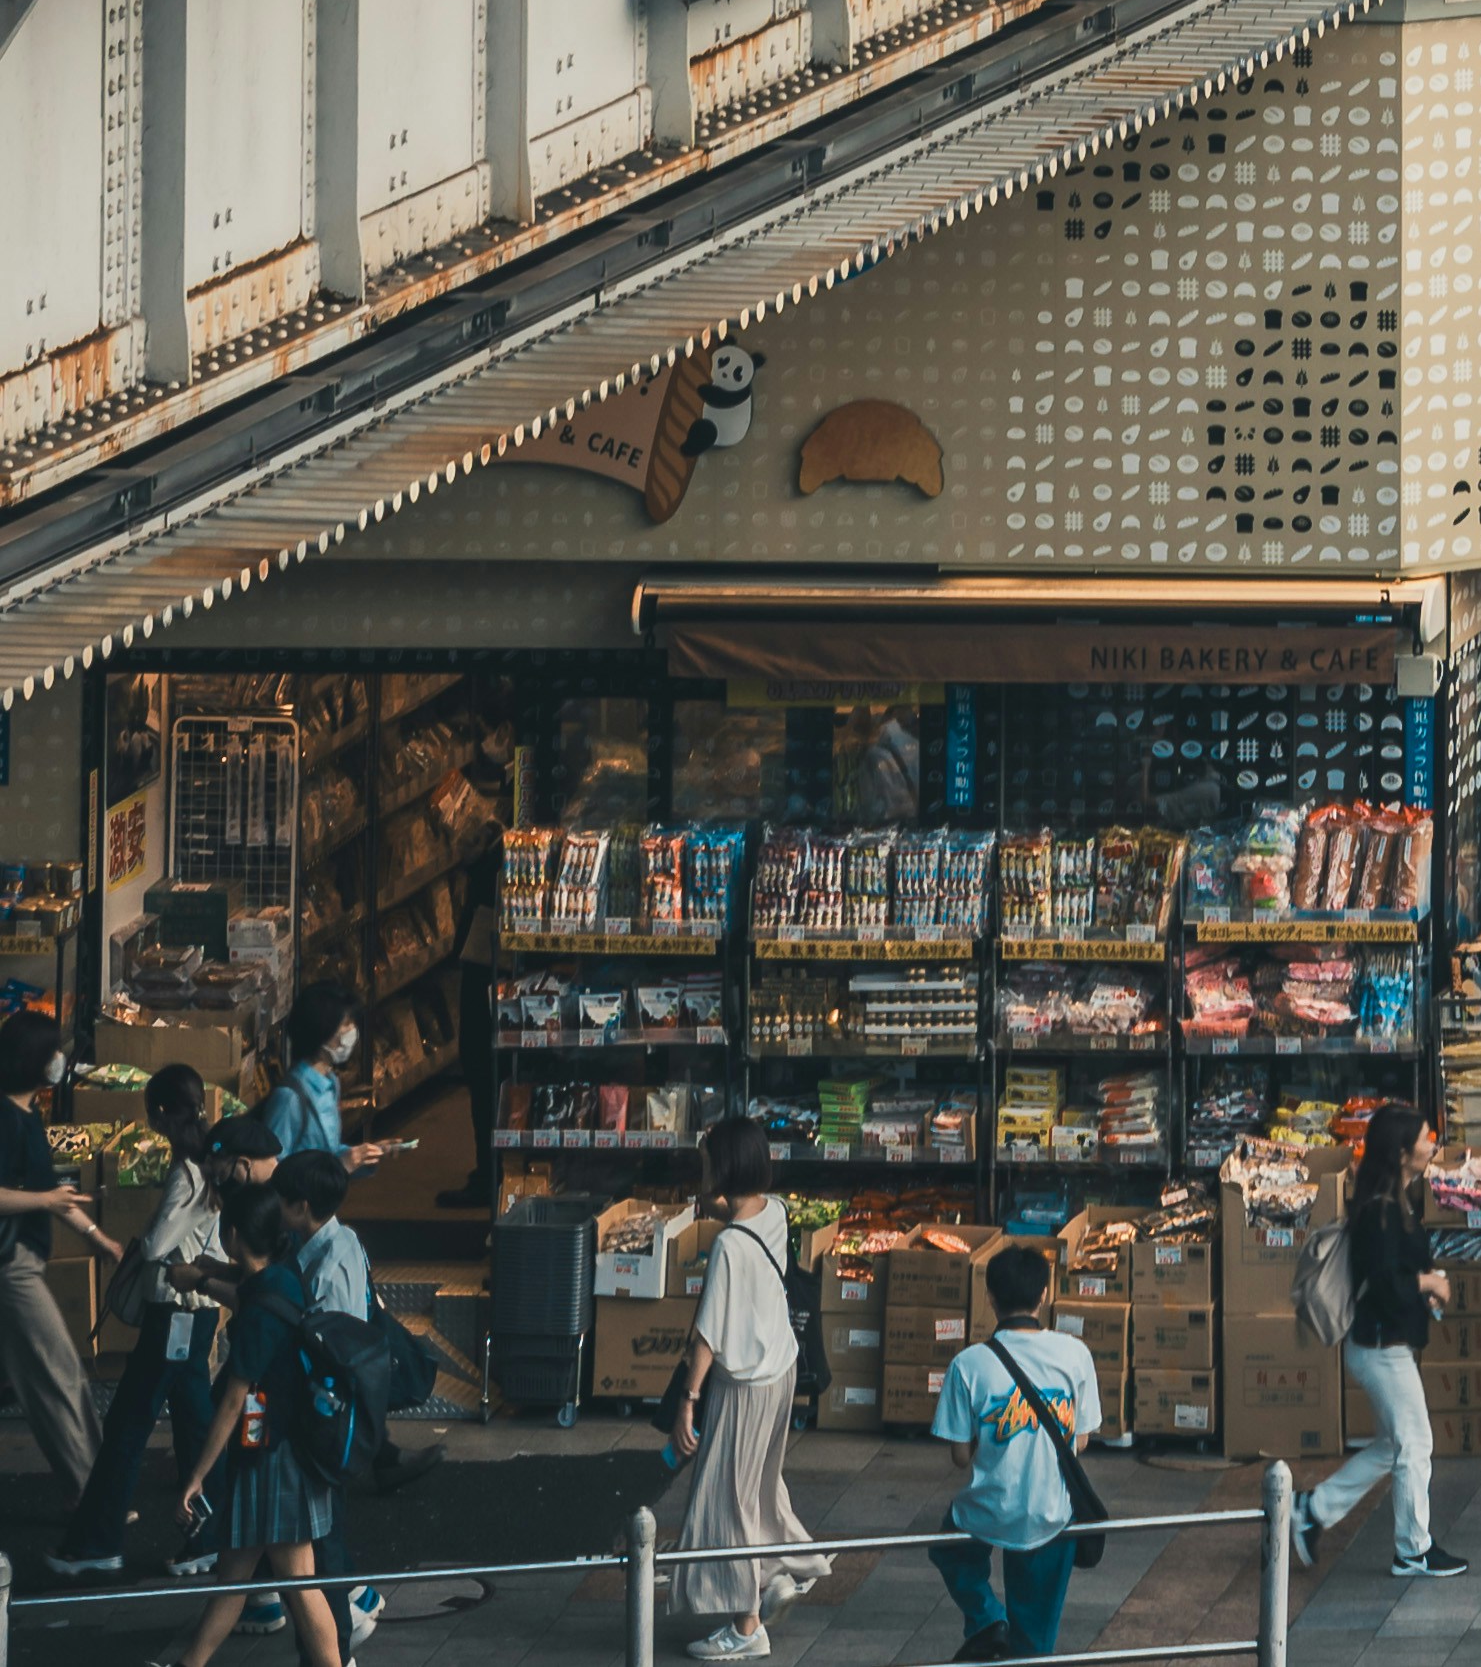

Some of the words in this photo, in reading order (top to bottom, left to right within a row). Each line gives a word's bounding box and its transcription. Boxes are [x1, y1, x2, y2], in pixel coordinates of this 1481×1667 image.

[559, 424, 575, 446] &
[587, 431, 644, 469] CAFE
[1090, 646, 1147, 672] NIKI
[1159, 646, 1268, 672] BAKERY
[1279, 647, 1298, 672] &
[1310, 646, 1379, 672] CAFE
